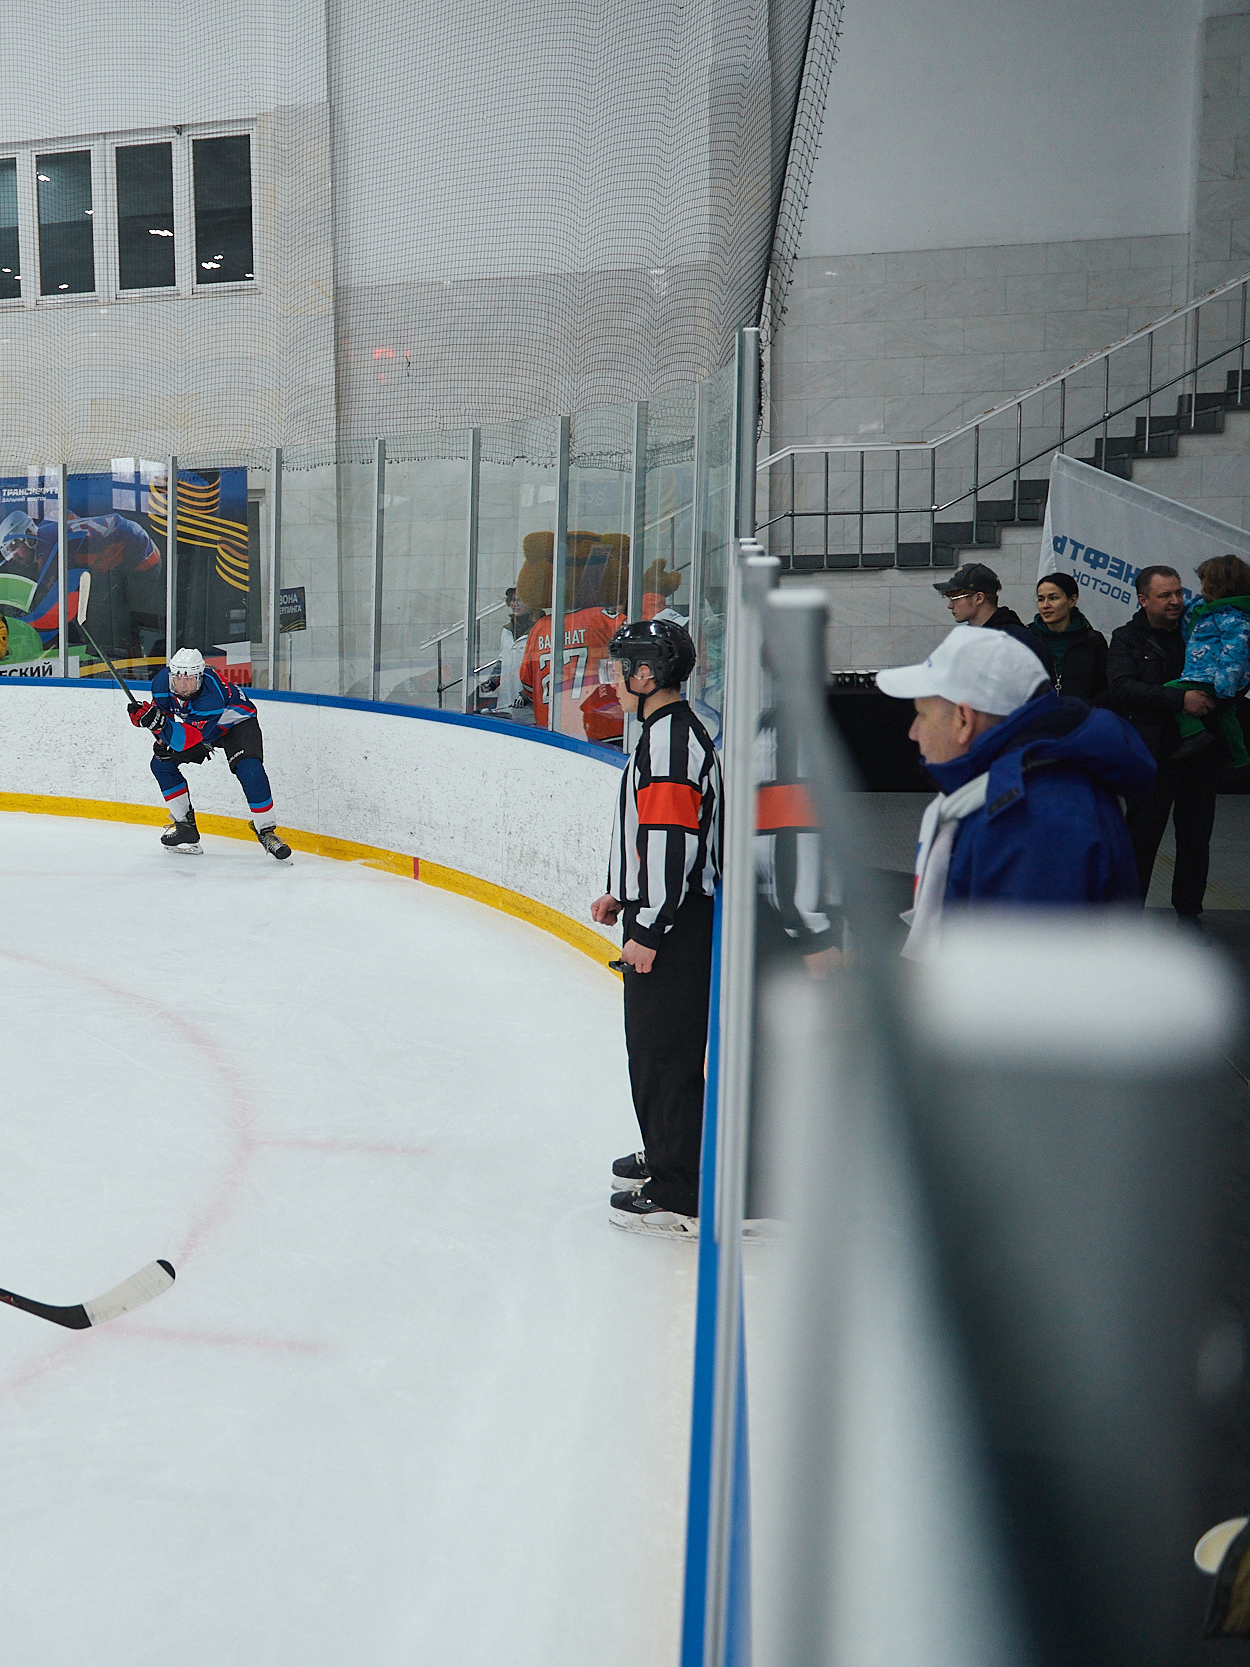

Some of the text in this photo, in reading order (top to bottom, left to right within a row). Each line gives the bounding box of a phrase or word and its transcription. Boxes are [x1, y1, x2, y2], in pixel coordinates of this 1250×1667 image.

[280, 604, 302, 615] ЕРЛИНГА
[538, 629, 586, 650] BAHAT
[0, 661, 53, 677] ЕСКИЙ
[539, 646, 588, 704] 27
